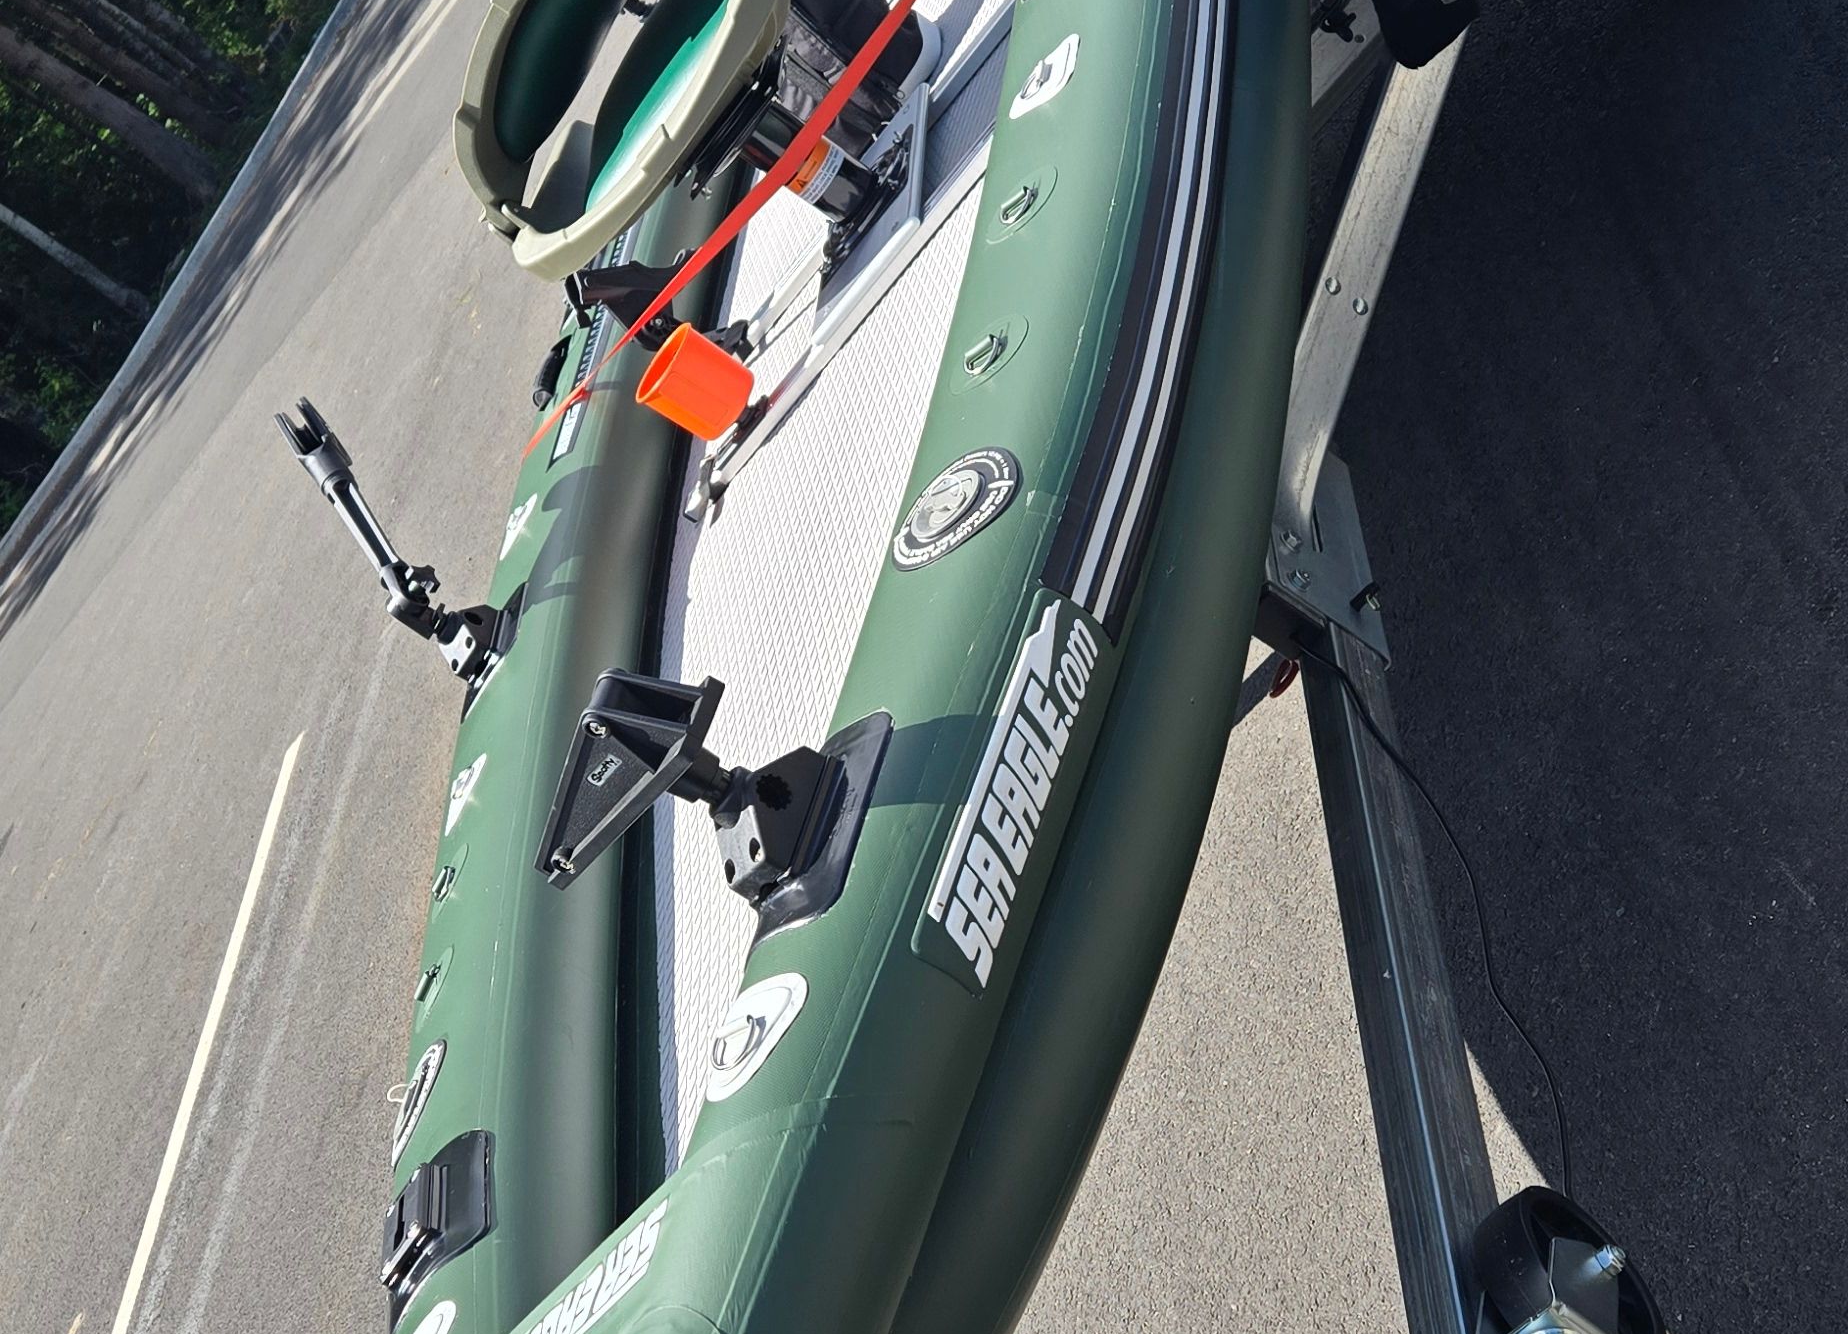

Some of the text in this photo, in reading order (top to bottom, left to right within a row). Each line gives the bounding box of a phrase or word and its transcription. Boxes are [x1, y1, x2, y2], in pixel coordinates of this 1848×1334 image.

[591, 758, 618, 783] Scotty
[945, 618, 1099, 989] SEA EAGLE.com
[592, 1197, 669, 1315] SEA
